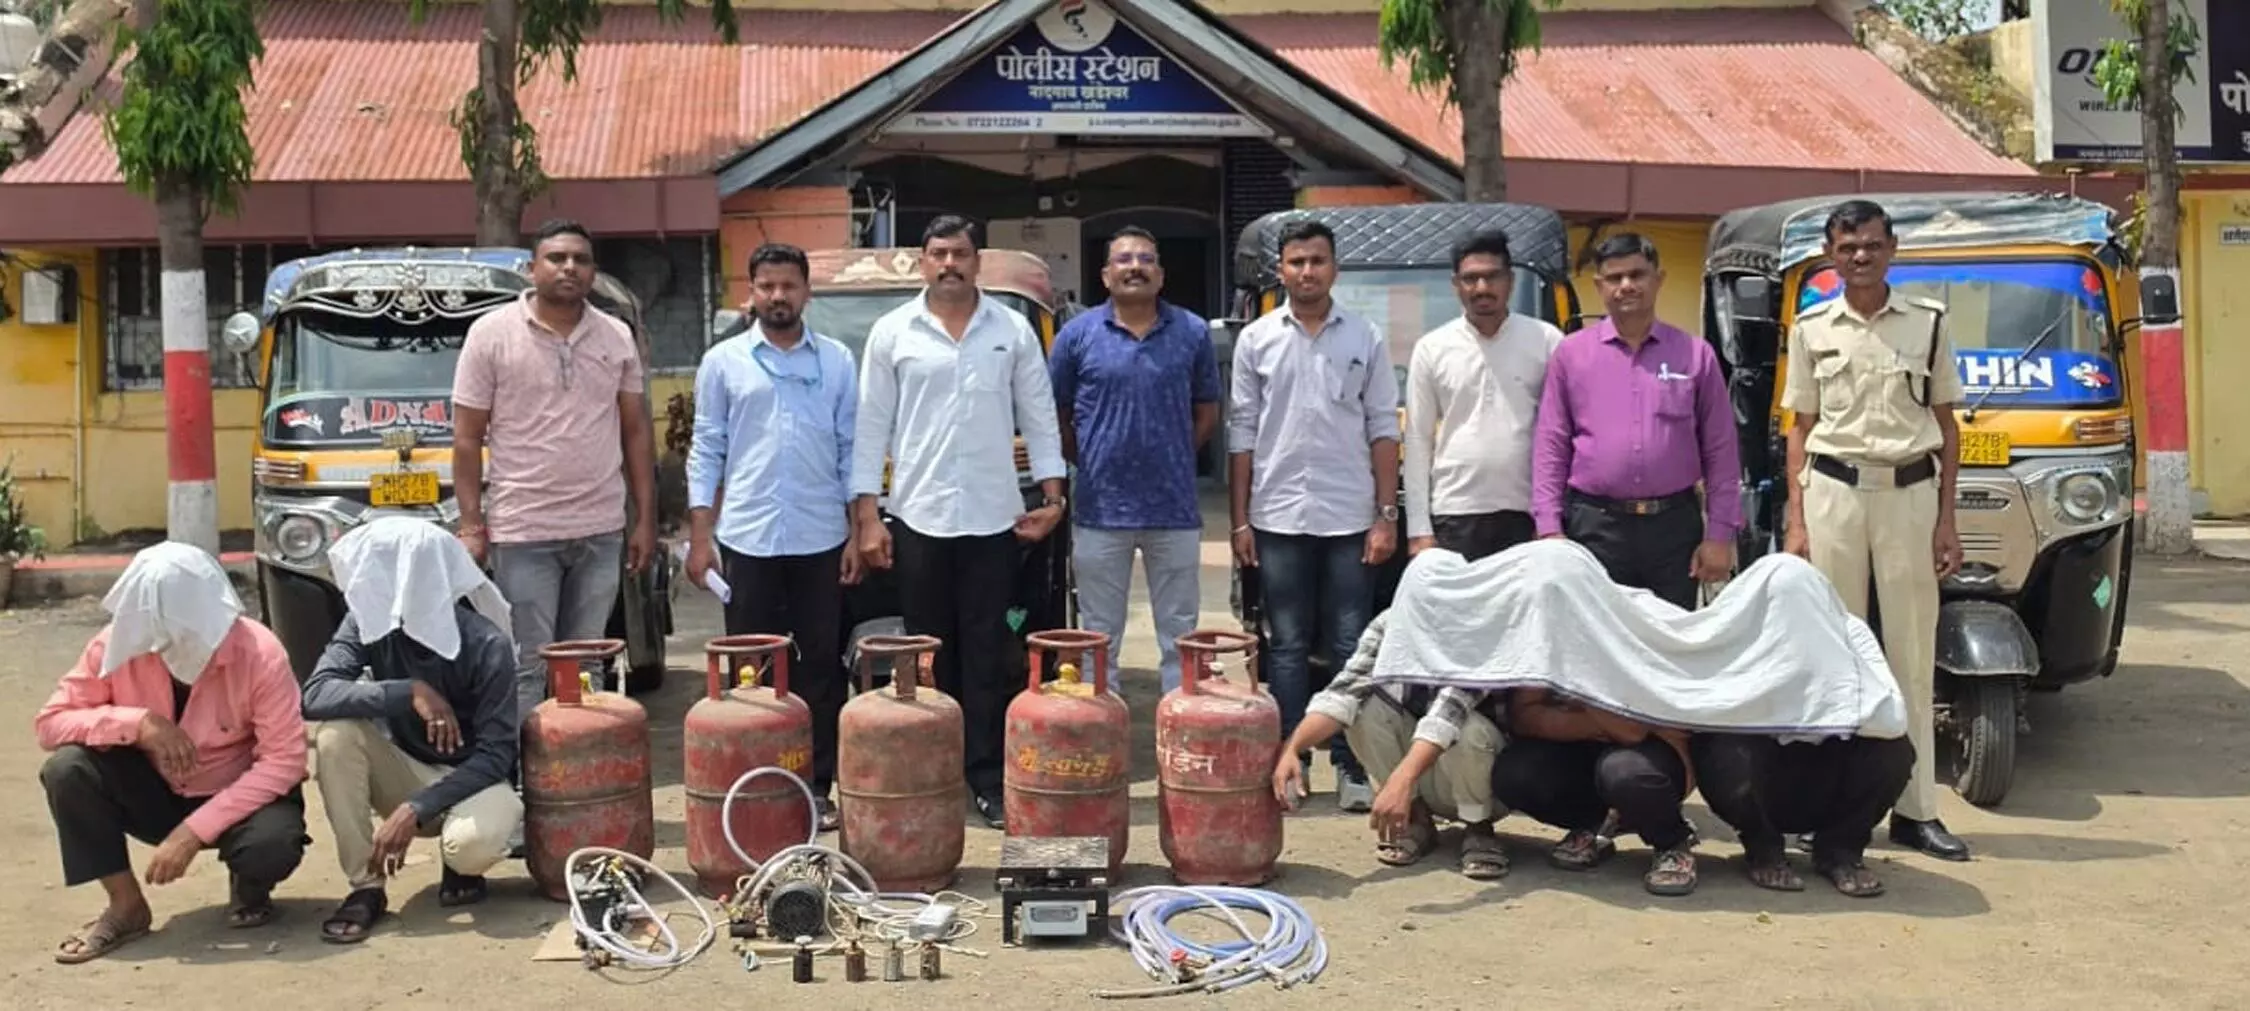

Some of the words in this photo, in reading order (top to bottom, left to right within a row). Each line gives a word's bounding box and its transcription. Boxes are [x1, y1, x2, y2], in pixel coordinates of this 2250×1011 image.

[995, 45, 1076, 81] पोलीस
[1080, 46, 1161, 82] स्टेशन
[1957, 356, 2053, 387] HIN
[340, 397, 454, 435] ADNA
